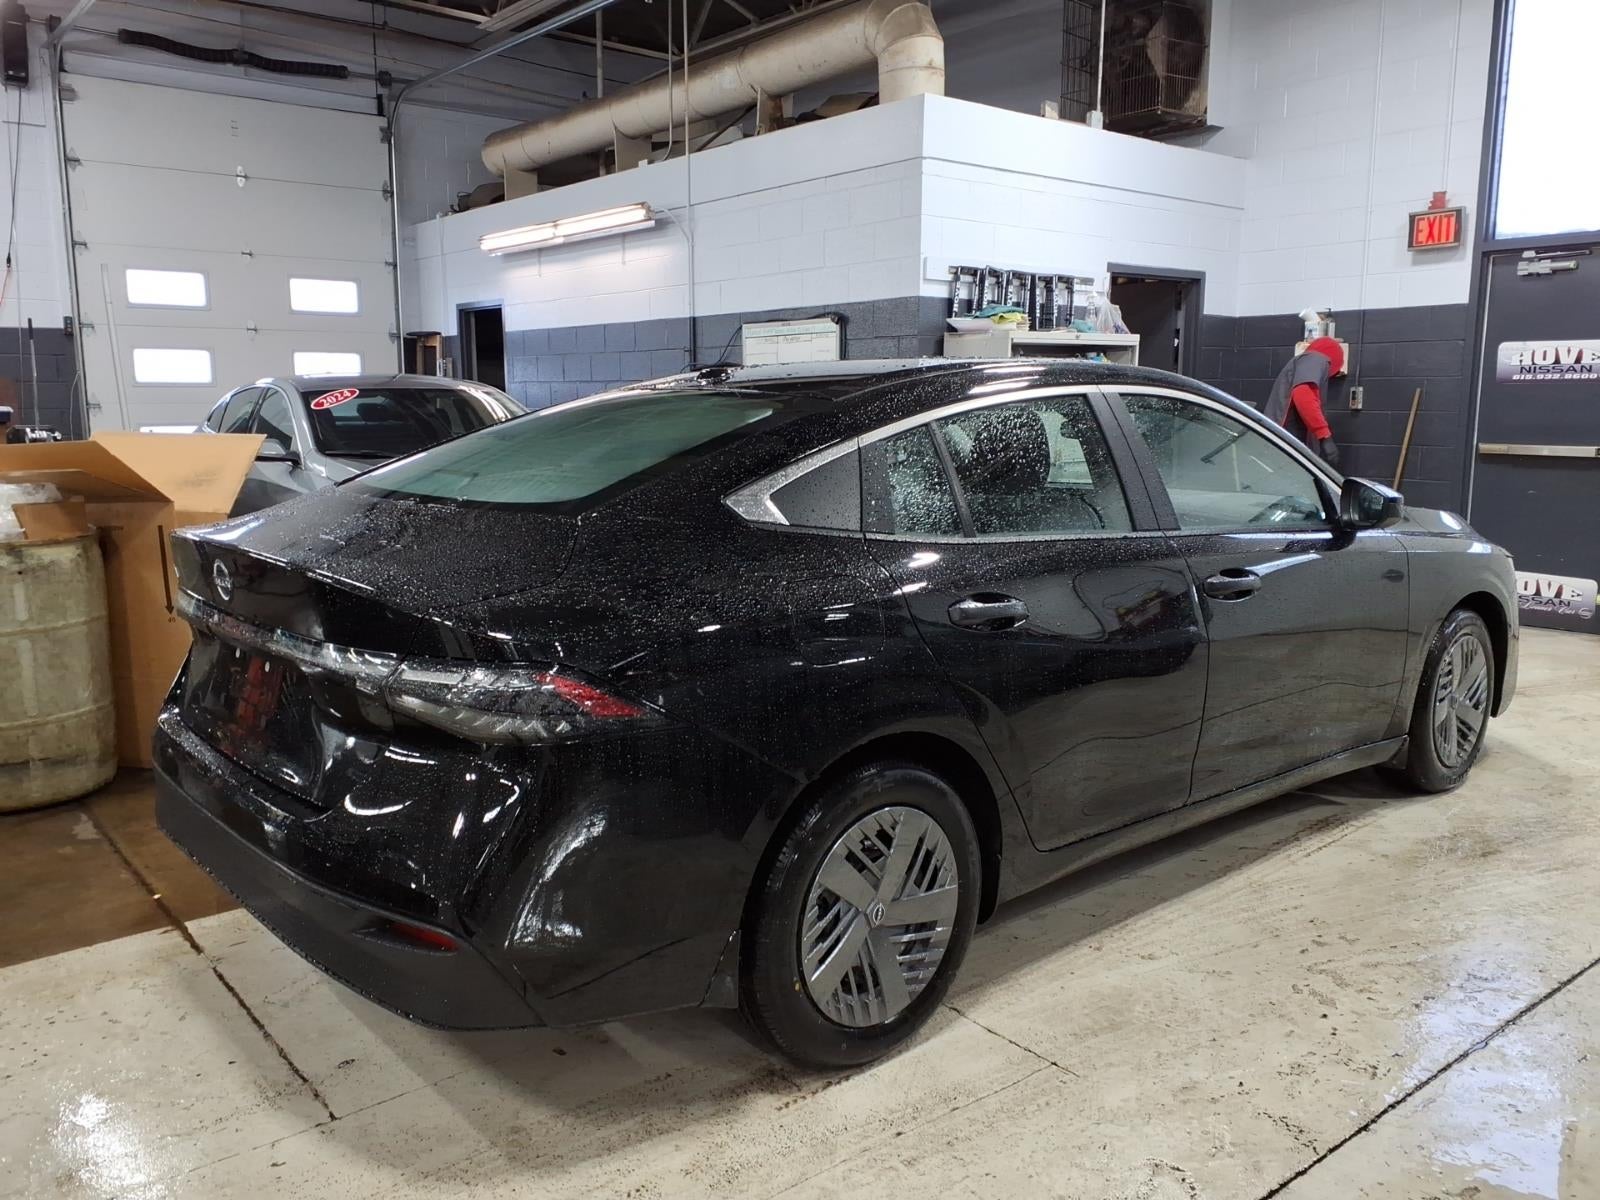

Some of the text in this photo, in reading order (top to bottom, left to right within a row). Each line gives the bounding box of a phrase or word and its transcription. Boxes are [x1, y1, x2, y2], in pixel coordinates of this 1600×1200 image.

[1415, 213, 1454, 245] EXIT
[1520, 365, 1593, 374] NISSAN
[319, 390, 351, 407] 2024
[1516, 578, 1583, 602] OVE
